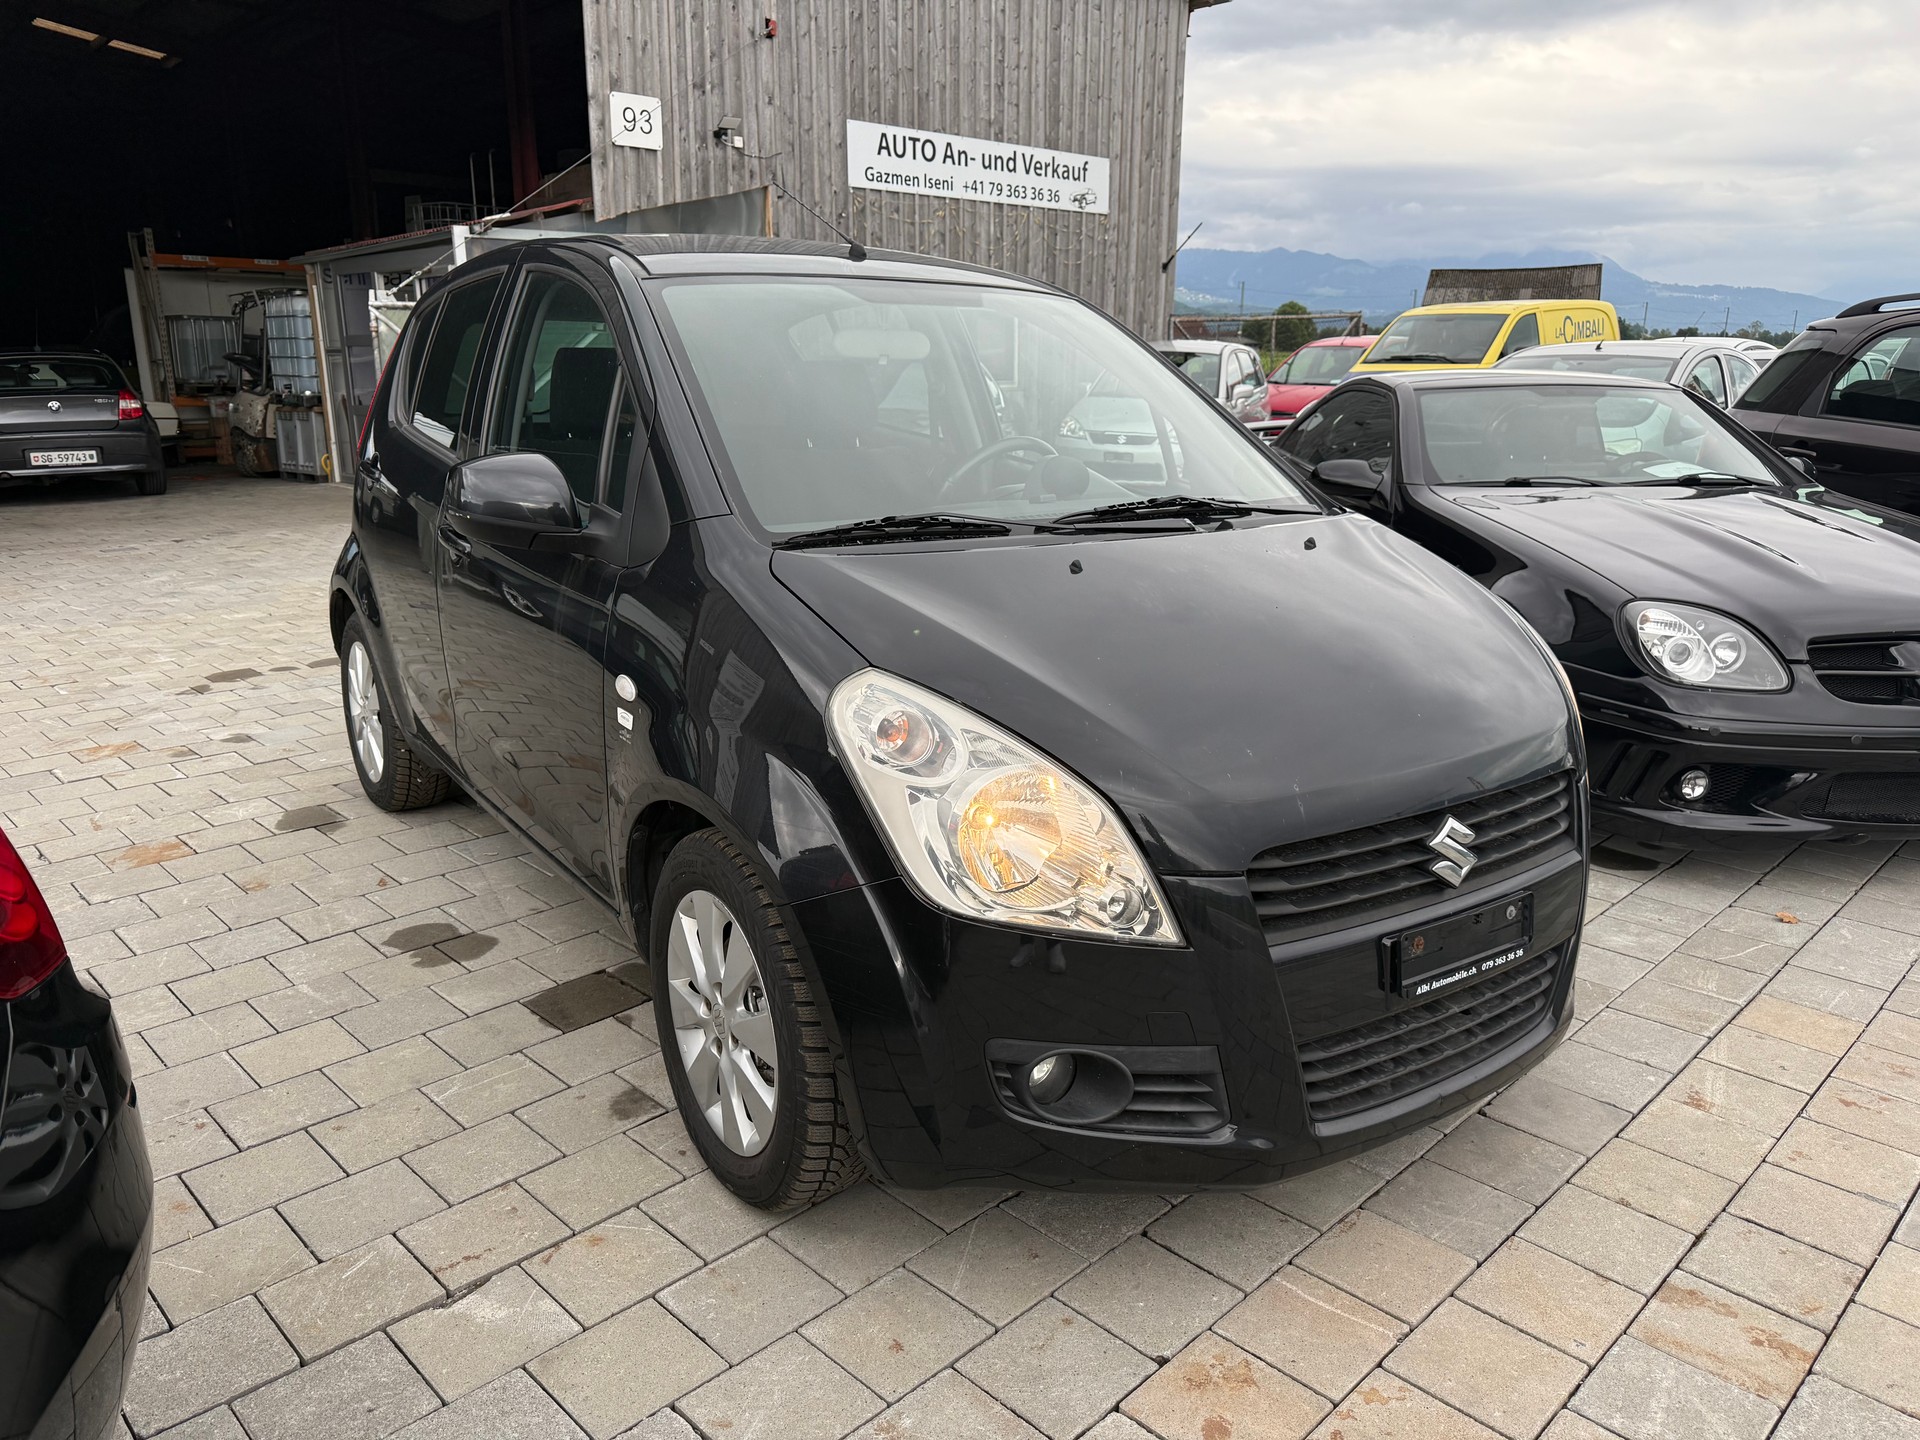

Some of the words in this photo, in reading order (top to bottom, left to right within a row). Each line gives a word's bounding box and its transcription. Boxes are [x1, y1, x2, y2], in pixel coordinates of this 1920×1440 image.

[622, 106, 653, 135] 93
[877, 132, 937, 163] AUTO
[942, 142, 976, 167] An-
[981, 150, 1017, 173] und
[1021, 152, 1089, 183] Verkauf
[864, 166, 920, 188] Gazmen
[924, 173, 954, 191] Iseni
[962, 179, 984, 195] +41
[988, 181, 1003, 196] 79
[1006, 184, 1027, 199] 363
[1030, 186, 1044, 201] 36
[1046, 188, 1060, 203] 36
[1555, 327, 1564, 339] LA
[1563, 316, 1605, 343] CIMBALI
[1416, 981, 1431, 995] Albi
[1431, 966, 1477, 990] Automobile.ch
[1481, 960, 1494, 971] 079
[1494, 955, 1506, 967] 363
[1505, 952, 1515, 963] 36
[1515, 948, 1524, 958] 36
